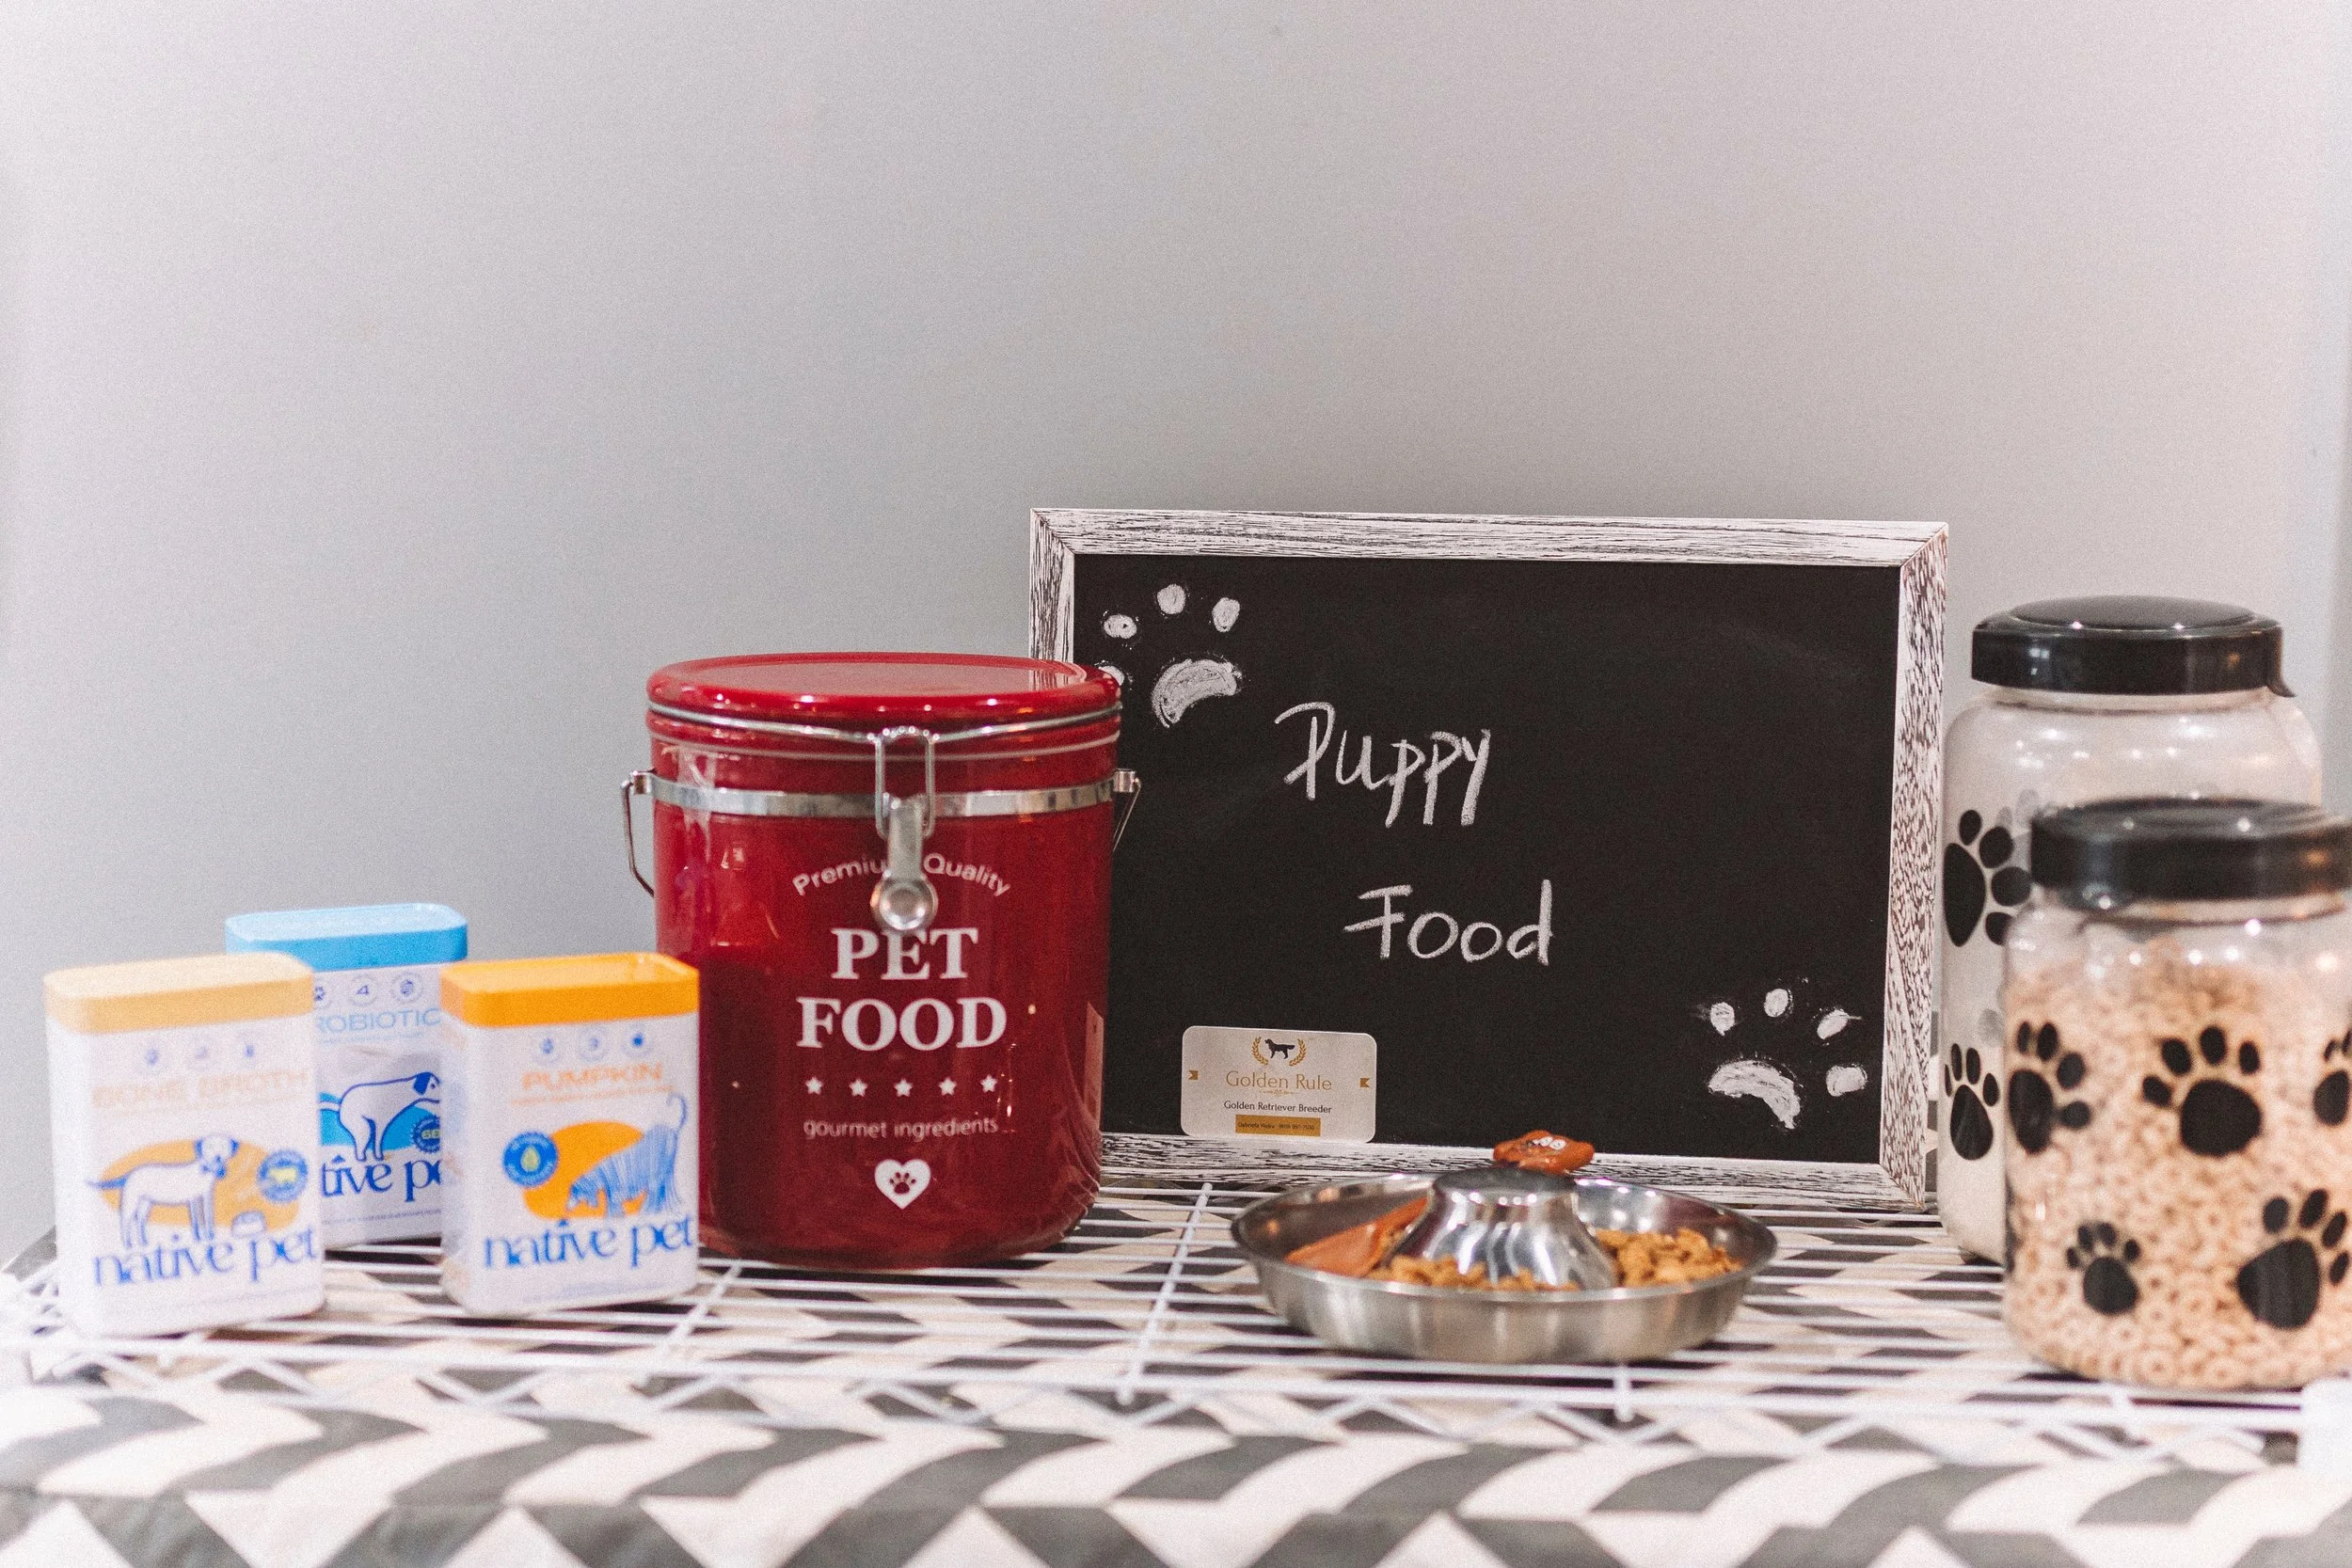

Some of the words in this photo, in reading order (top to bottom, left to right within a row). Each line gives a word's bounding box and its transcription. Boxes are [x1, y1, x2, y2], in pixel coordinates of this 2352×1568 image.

[1274, 702, 1490, 828] Puppy
[792, 854, 887, 895] Premiu
[923, 853, 1010, 896] Quality
[1343, 879, 1552, 966] Food
[831, 927, 978, 980] PET
[317, 1007, 440, 1033] ROBIOTIC
[796, 997, 1007, 1051] FOOD
[1226, 1070, 1288, 1088] Golden
[1296, 1073, 1332, 1090] Rule
[803, 1119, 886, 1139] gourmet
[895, 1117, 998, 1142] ingredients
[1224, 1101, 1255, 1110] Golden
[1258, 1102, 1295, 1112] Retriever
[1299, 1104, 1332, 1114] Breeder
[321, 1154, 393, 1197] tive
[94, 1234, 234, 1287] native
[248, 1224, 317, 1283] pet
[485, 1218, 617, 1268] native
[629, 1214, 693, 1269] pet
